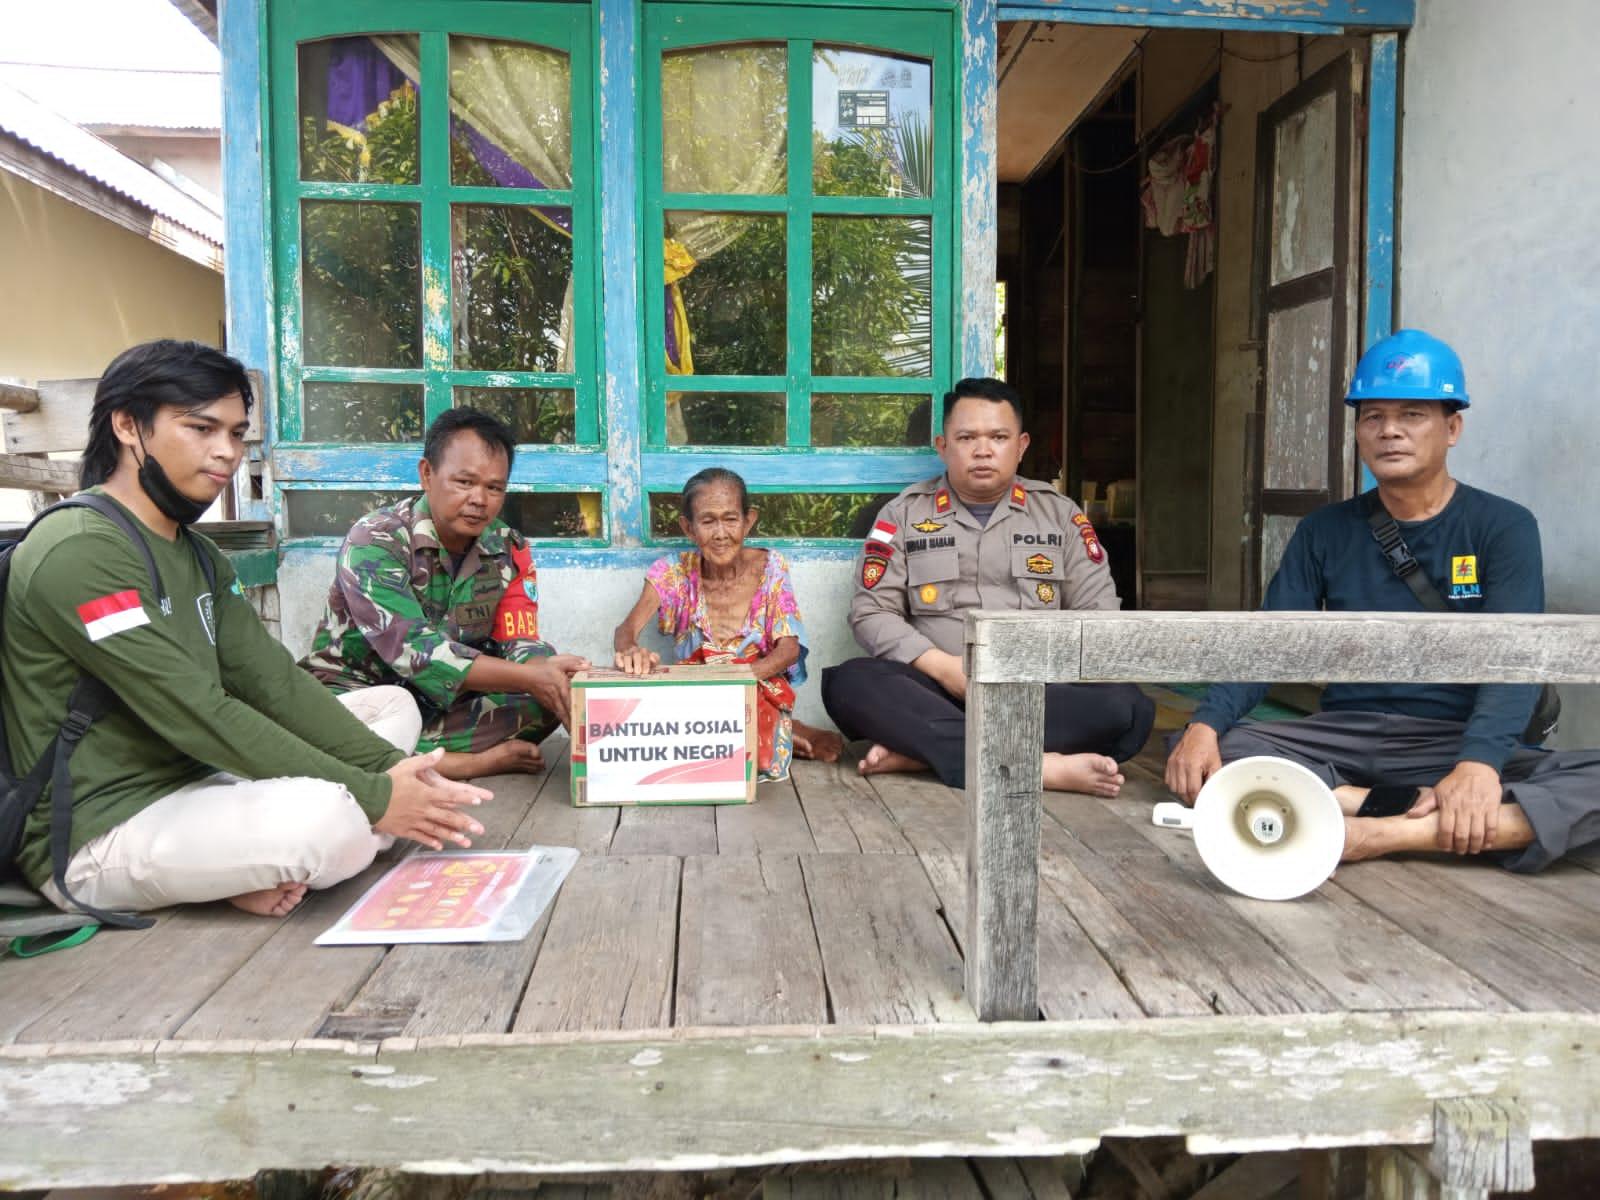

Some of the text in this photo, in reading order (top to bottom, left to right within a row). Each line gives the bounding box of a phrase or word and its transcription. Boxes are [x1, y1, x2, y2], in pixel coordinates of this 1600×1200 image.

[1013, 533, 1062, 546] POLRI
[1453, 584, 1480, 595] PLN
[464, 604, 490, 619] TNI
[589, 720, 743, 737] BANTUAN SOSIAL
[599, 746, 668, 762] UNTUK
[673, 744, 734, 760] NEGRI
